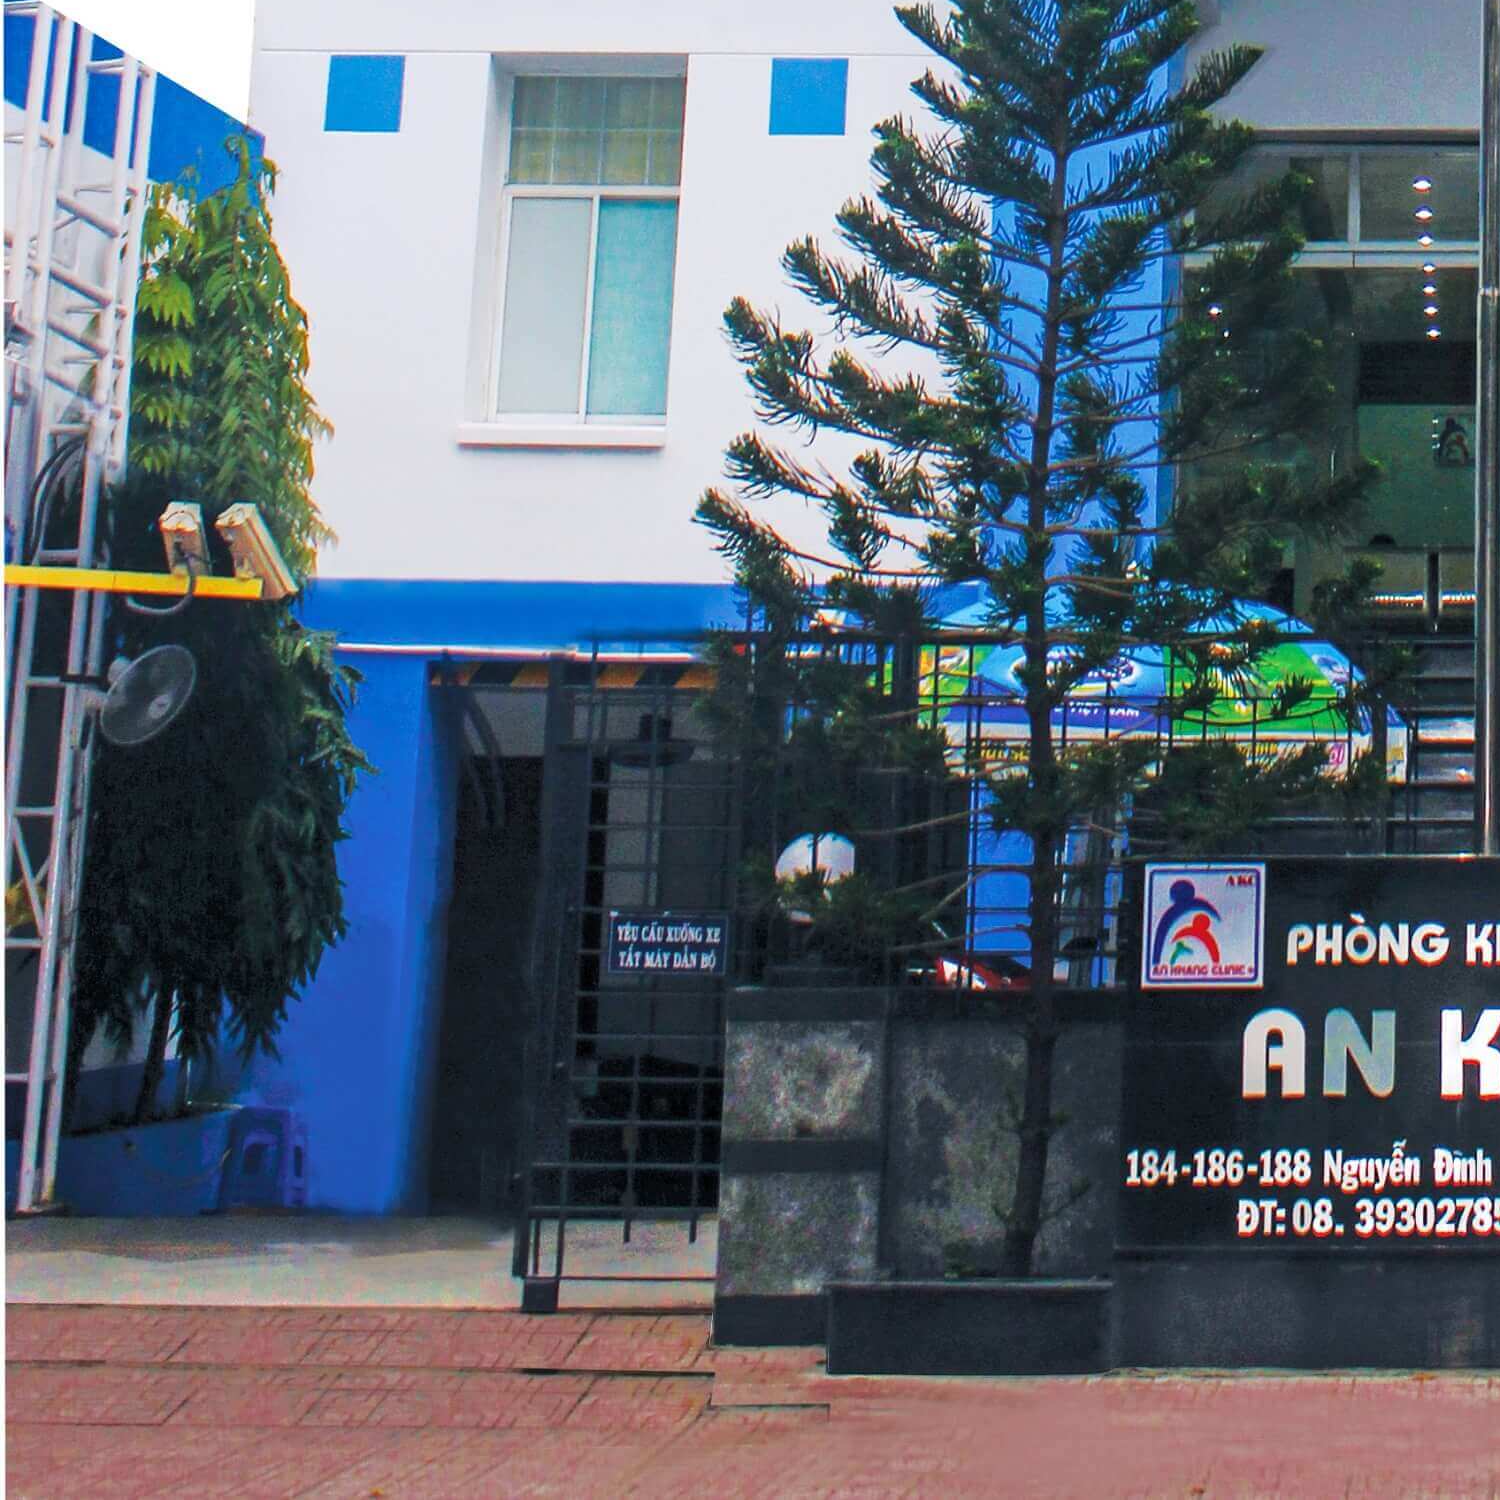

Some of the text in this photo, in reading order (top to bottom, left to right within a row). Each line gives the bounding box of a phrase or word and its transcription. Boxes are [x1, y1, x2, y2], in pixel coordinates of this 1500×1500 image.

[617, 922, 640, 943] YÊU
[705, 926, 722, 943] XE
[1287, 911, 1450, 965] PHÒNG
[1241, 1006, 1396, 1098] AN
[1125, 1148, 1312, 1187] 184-186-188
[1322, 1139, 1421, 1194] Nguyễn
[1432, 1146, 1493, 1187] Đình
[1236, 1198, 1287, 1237] ĐT:
